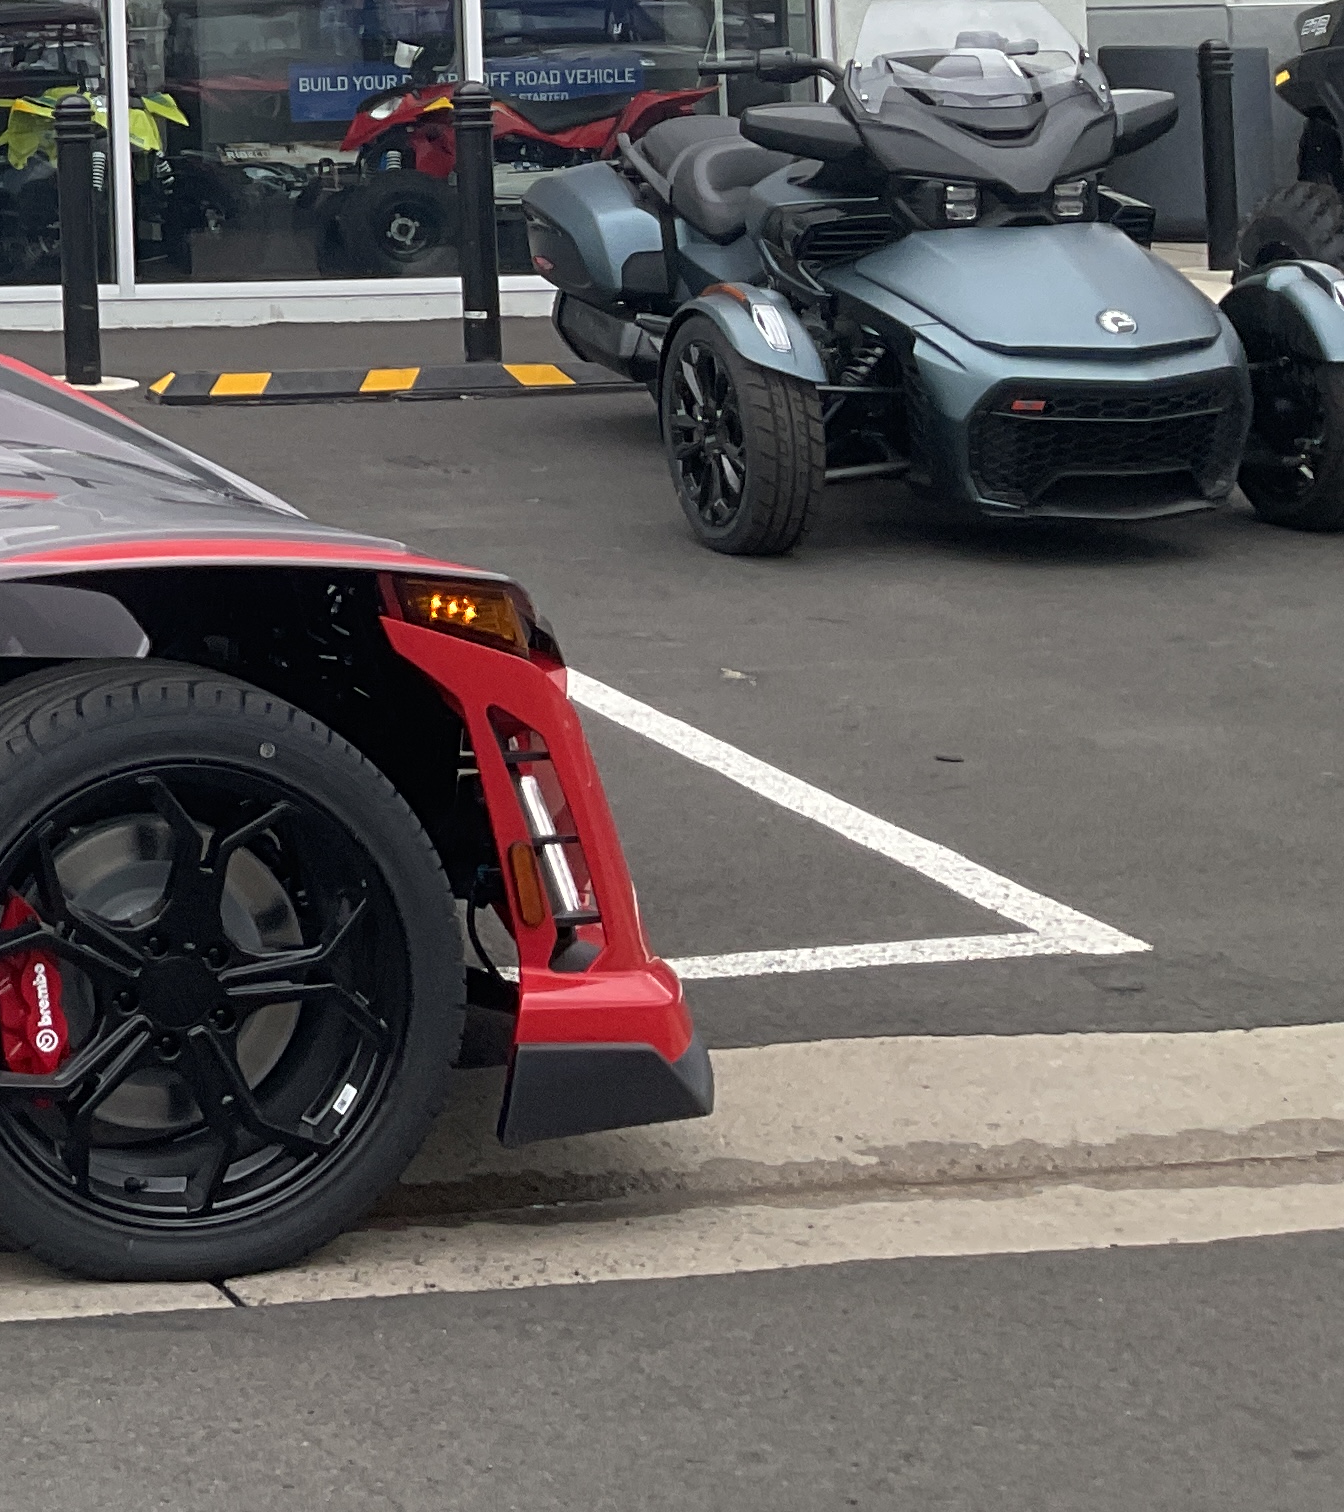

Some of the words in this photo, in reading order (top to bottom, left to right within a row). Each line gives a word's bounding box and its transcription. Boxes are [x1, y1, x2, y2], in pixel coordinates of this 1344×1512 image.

[298, 76, 348, 93] BUILD
[352, 74, 398, 91] YOUR
[515, 69, 561, 86] ROAD
[564, 67, 636, 86] VEHICLE
[32, 962, 53, 1028] brembo
